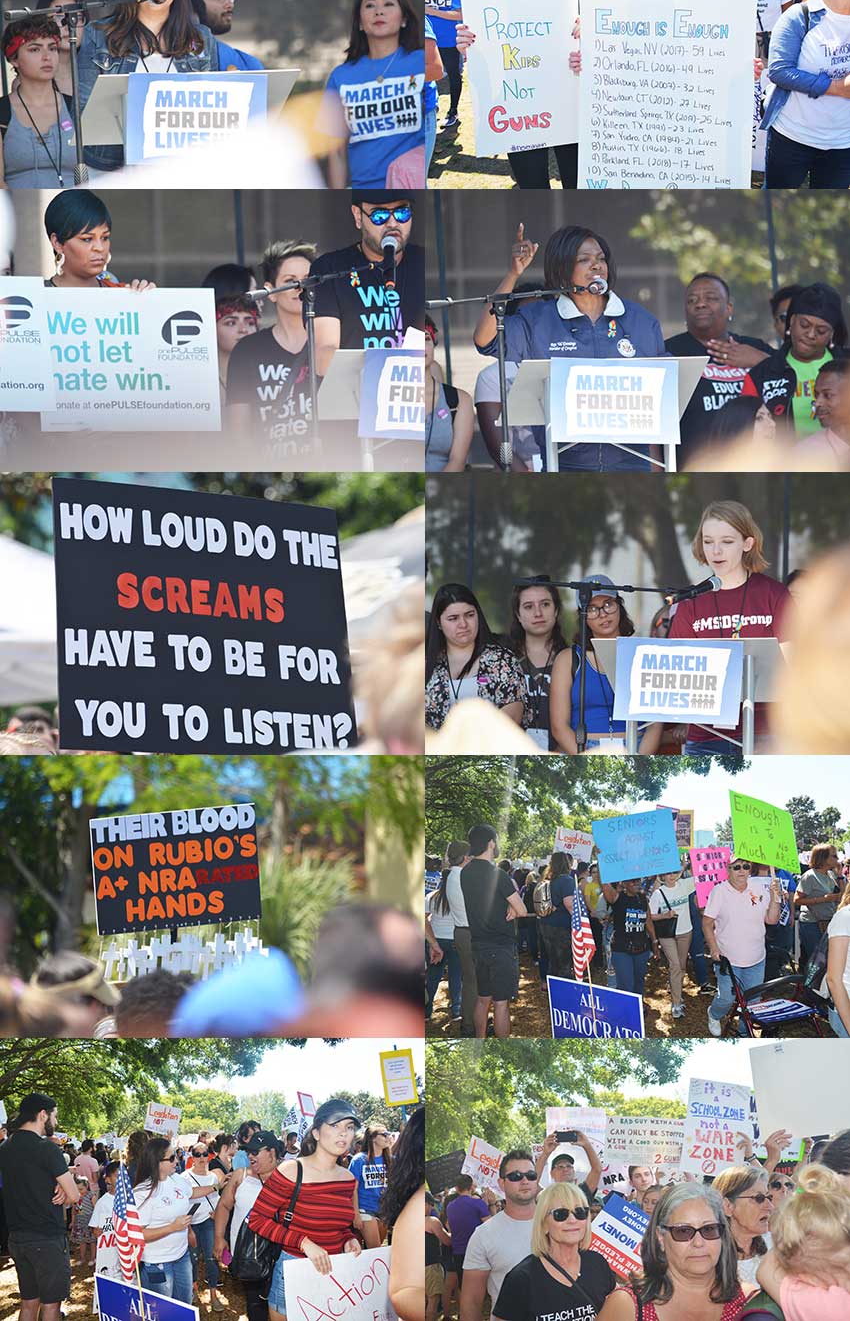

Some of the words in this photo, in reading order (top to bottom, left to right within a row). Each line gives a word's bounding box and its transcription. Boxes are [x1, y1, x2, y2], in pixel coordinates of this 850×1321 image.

[155, 90, 228, 108] MARCH
[345, 83, 405, 103] MARCH
[348, 104, 381, 121] FOR
[381, 95, 416, 114] OUR
[155, 111, 195, 129] FOR
[199, 111, 239, 129] OUR
[351, 115, 395, 136] LIVES
[357, 286, 400, 308] We
[47, 311, 86, 335] We
[95, 312, 139, 335] will
[360, 308, 403, 331] will
[100, 340, 133, 363] let
[115, 367, 171, 391] win.
[576, 374, 642, 391] MARCH
[94, 401, 210, 411] onePULSEfoundation.org
[576, 394, 615, 410] FOR
[618, 394, 654, 411] OUR
[577, 412, 628, 429] LIVES
[60, 502, 132, 544] HOW
[142, 509, 227, 554] LOUD
[233, 521, 276, 560] DO
[283, 529, 339, 570] THE
[117, 572, 284, 623] SCREAMS
[693, 615, 772, 632] #MSDStrong
[64, 628, 155, 668] HAVE
[168, 634, 212, 672] TO
[224, 639, 266, 677] BE
[278, 645, 341, 685] FOR
[641, 654, 707, 672] MARCH
[641, 672, 677, 689] FOR
[679, 675, 717, 691] OUR
[640, 691, 690, 708] LIVES
[75, 699, 146, 738] YOU
[162, 703, 209, 741] TO
[224, 708, 353, 750] LISTEN?
[92, 813, 167, 844] THEIR
[171, 805, 255, 836] BLOOD
[94, 844, 134, 871] ON
[149, 834, 257, 866] RUBIO'S
[97, 876, 128, 900] A+
[138, 867, 197, 895] NRA
[196, 864, 258, 884] RATED
[126, 890, 224, 923] HANDS
[580, 993, 604, 1011] ALL
[690, 1101, 722, 1117] SCHOOL
[723, 1105, 745, 1120] ZONE
[695, 1129, 735, 1145] WAR
[689, 1145, 735, 1162] ZONE
